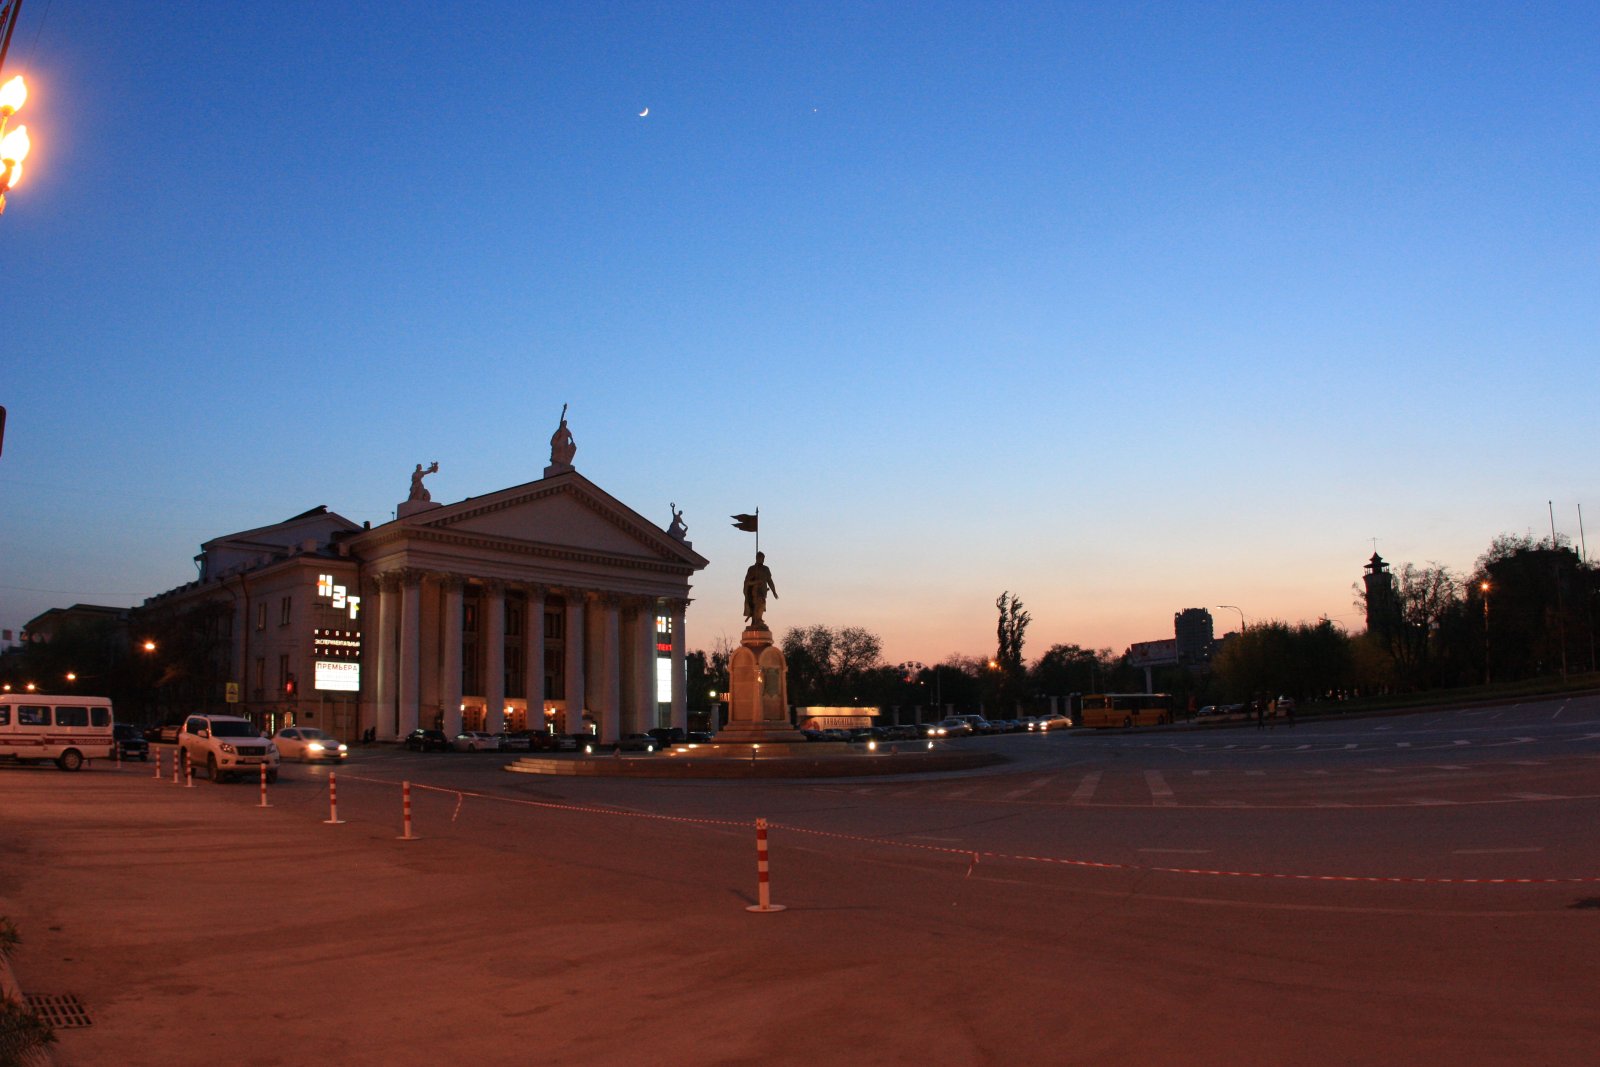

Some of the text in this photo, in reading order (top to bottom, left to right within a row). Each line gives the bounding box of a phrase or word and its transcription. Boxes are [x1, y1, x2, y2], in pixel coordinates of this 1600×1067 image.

[314, 629, 360, 638] НОВЫЙ
[314, 648, 360, 656] ТЕАТР
[316, 662, 358, 671] ПРЕМЬЕРА
